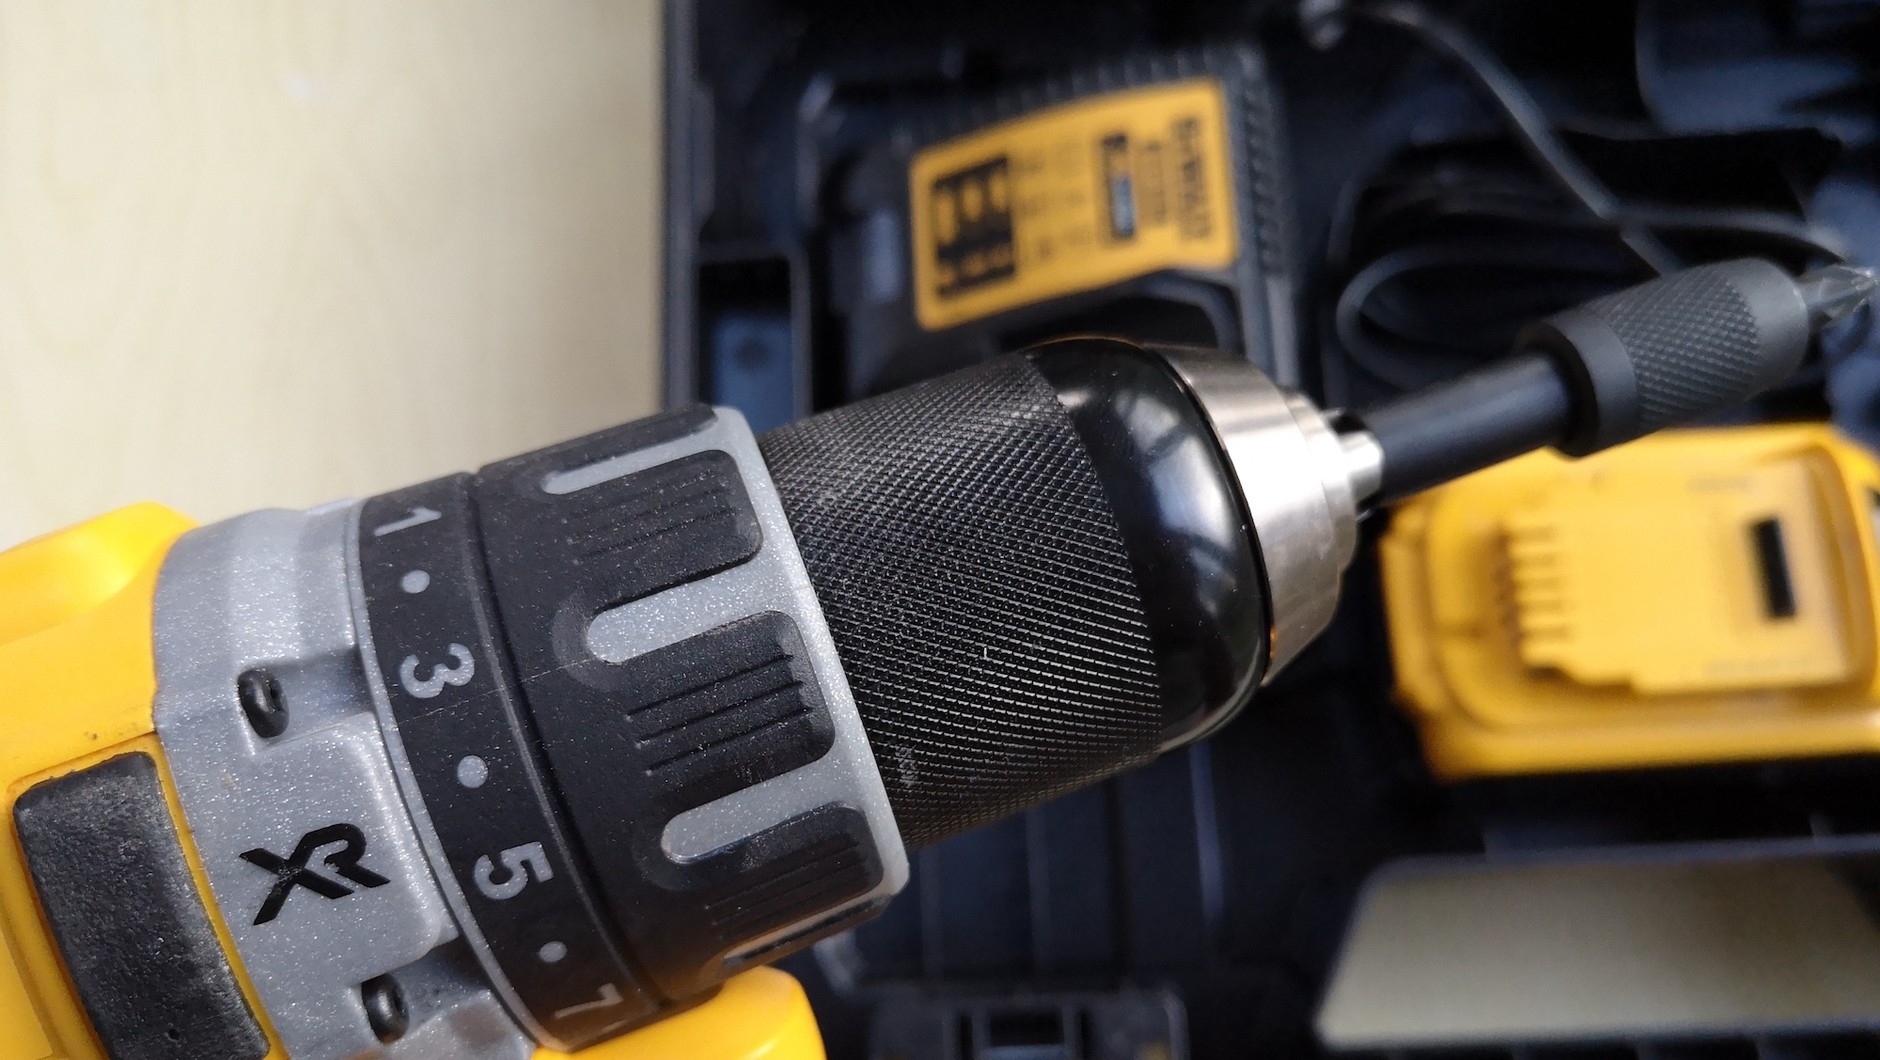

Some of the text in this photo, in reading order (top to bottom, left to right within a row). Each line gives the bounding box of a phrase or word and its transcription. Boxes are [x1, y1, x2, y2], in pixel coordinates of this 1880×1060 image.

[239, 822, 391, 926] XR
[374, 507, 624, 1021] 1 3 5 7
